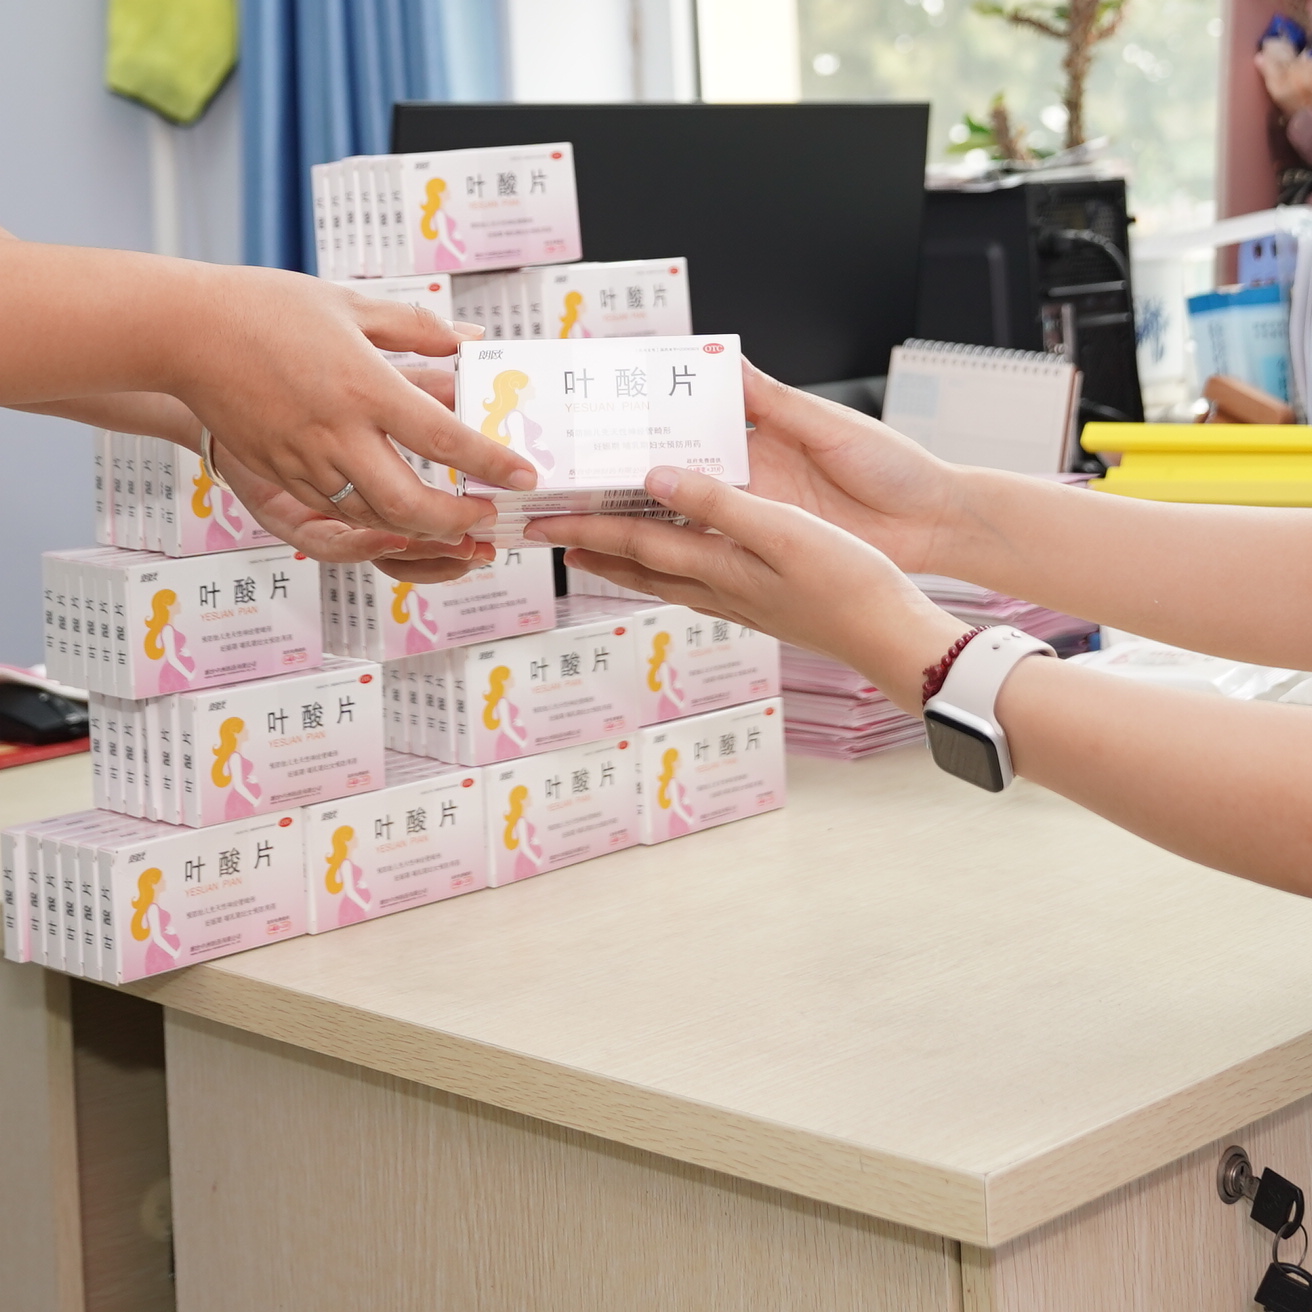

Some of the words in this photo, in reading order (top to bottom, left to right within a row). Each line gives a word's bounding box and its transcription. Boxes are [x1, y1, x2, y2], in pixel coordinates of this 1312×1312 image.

[466, 169, 547, 198] 叶酸片
[599, 283, 669, 311] 叶酸片
[478, 349, 504, 360] 朗欧
[704, 344, 724, 352] OTC
[564, 365, 697, 398] 叶酸片
[565, 402, 615, 413] YESUAN
[622, 401, 650, 411] PIAN
[199, 571, 291, 609] 叶酸片
[530, 646, 611, 681] 叶酸片
[267, 695, 356, 735] 叶酸片
[693, 726, 763, 762] 叶酸片
[544, 761, 616, 800] 叶酸片
[374, 799, 459, 840] 叶酸片
[184, 839, 275, 883] 叶酸片
